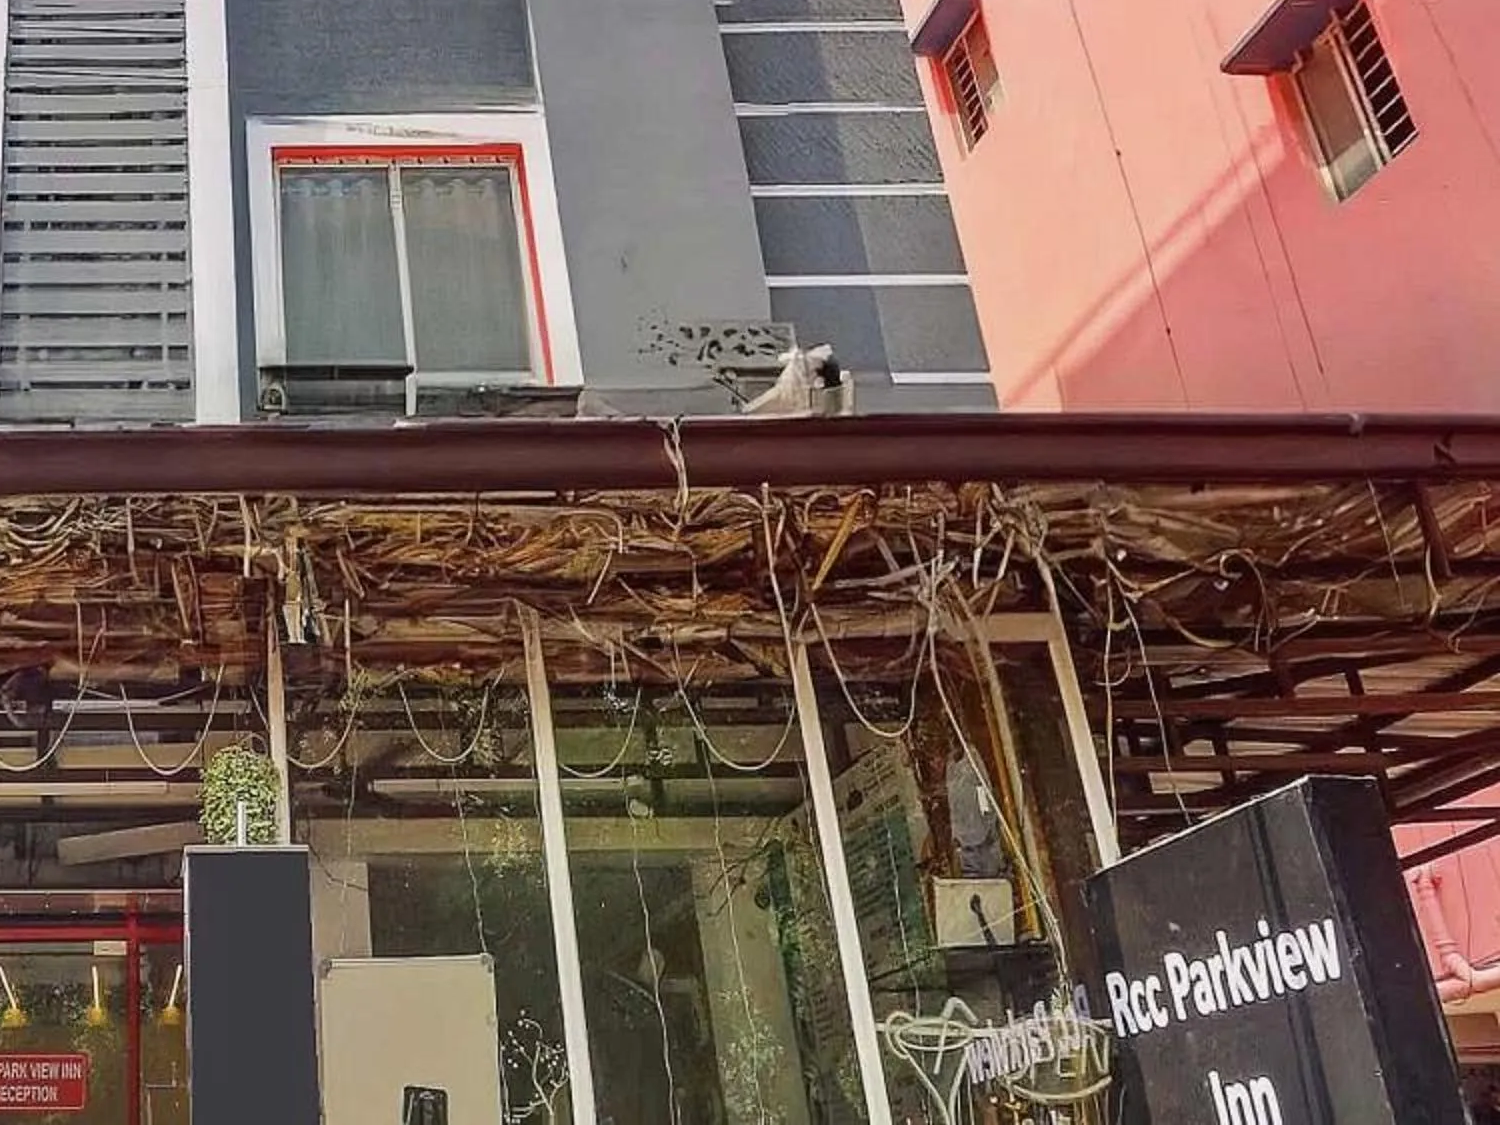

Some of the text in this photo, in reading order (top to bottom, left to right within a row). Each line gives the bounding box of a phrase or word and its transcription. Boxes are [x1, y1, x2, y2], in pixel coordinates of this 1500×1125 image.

[1105, 971, 1170, 1038] Rcc
[1164, 918, 1341, 1021] Parkview
[30, 1062, 60, 1080] VIEW
[60, 1062, 82, 1080] INN
[1207, 1070, 1284, 1125] Inn
